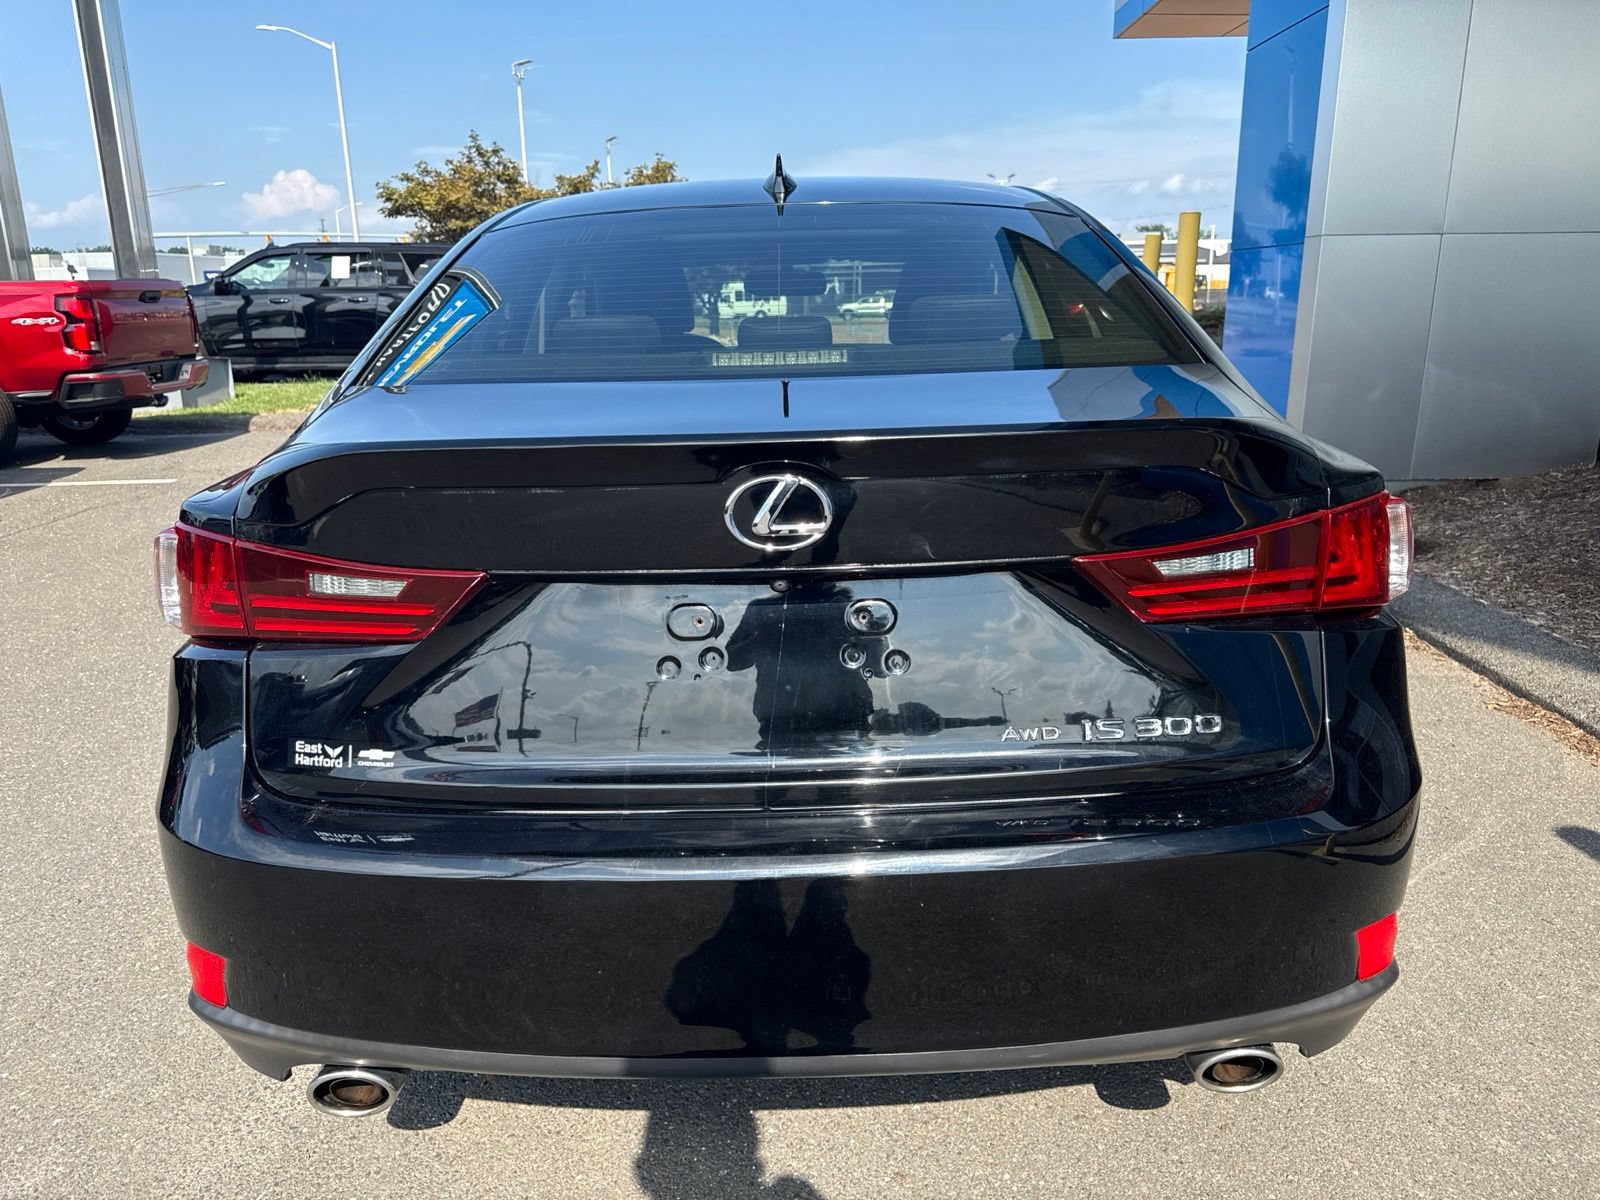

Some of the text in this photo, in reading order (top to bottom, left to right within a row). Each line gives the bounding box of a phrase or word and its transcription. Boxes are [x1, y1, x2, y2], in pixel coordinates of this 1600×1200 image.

[1001, 714, 1222, 742] AWD IS 300
[295, 740, 323, 754] East
[294, 753, 343, 769] Hartford
